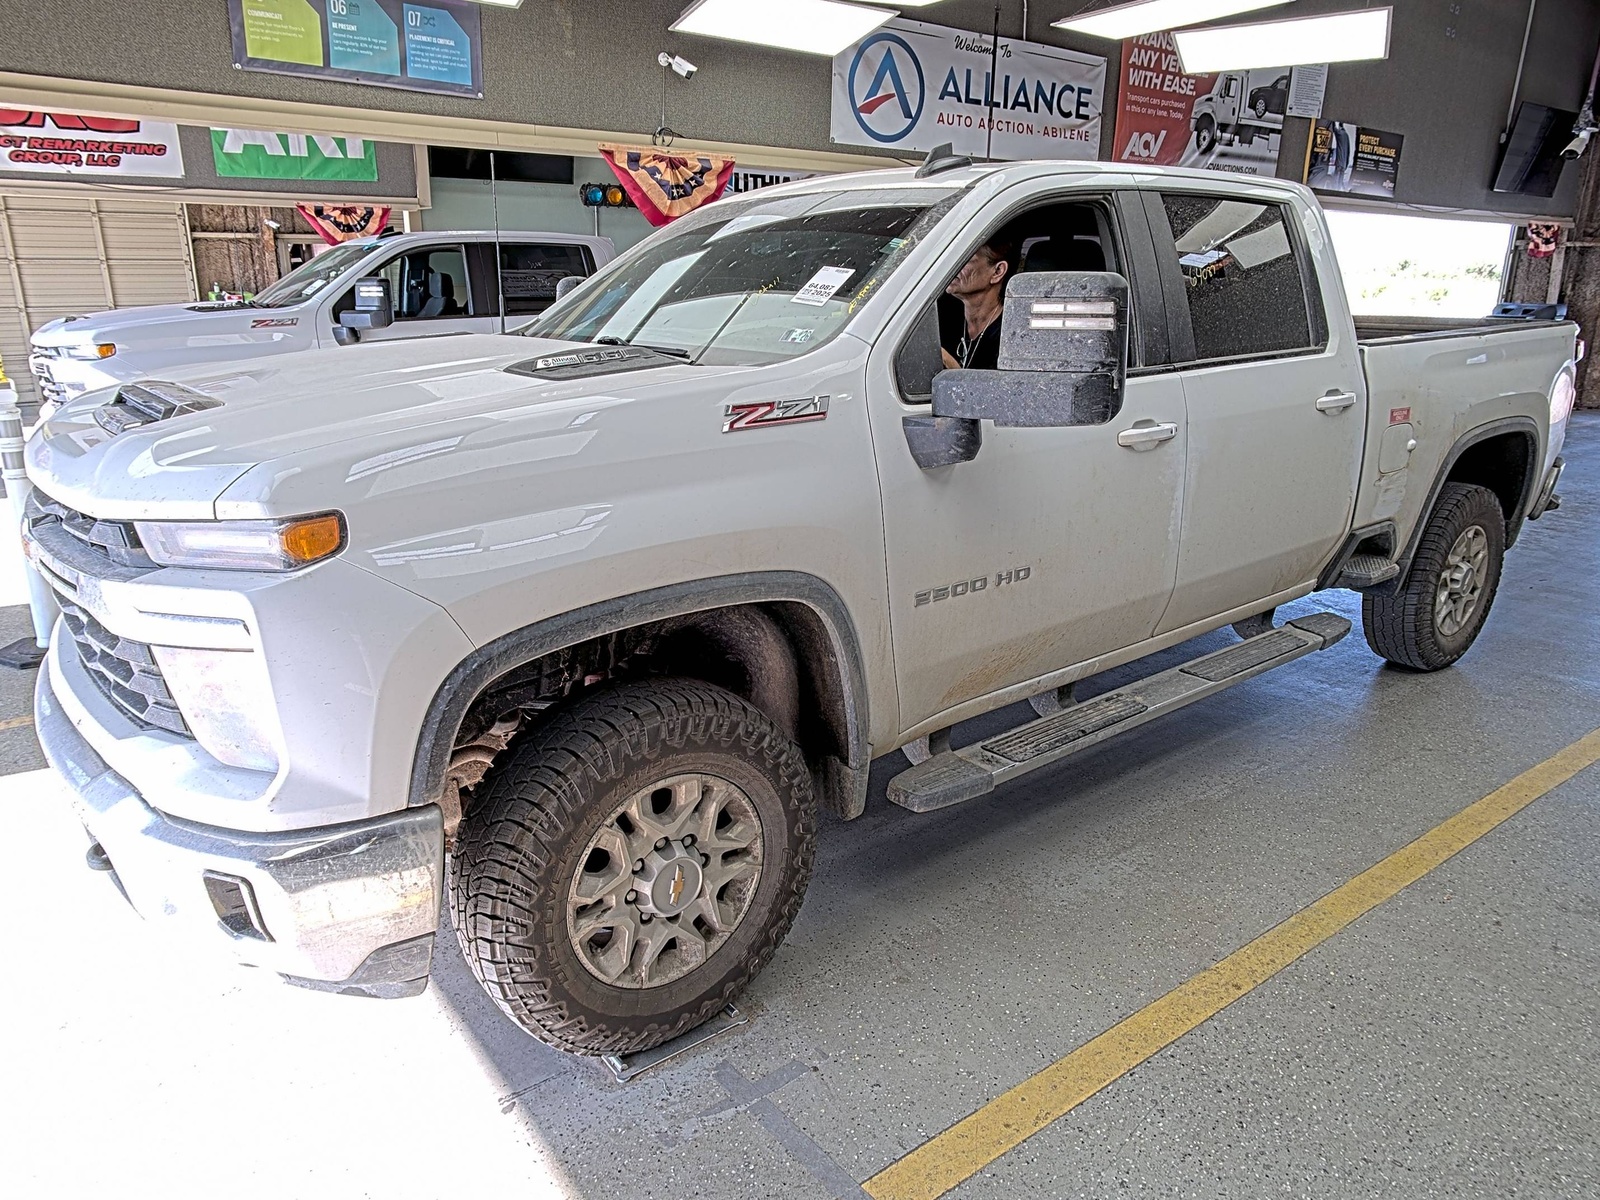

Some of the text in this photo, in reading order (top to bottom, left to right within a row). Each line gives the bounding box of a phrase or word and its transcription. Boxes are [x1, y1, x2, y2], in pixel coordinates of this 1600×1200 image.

[330, 0, 347, 15] 06
[408, 10, 421, 26] 07
[409, 33, 432, 42] PLACEMENT
[437, 37, 455, 47] CRITICAL
[1000, 44, 1012, 58] To
[1129, 47, 1160, 68] ANY
[1128, 68, 1196, 96] WITH EASE.
[938, 66, 1092, 120] ALLIANCE
[1127, 92, 1186, 109] Transport cars purchased
[1126, 103, 1131, 111] in
[1131, 104, 1141, 113] this
[1147, 108, 1156, 116] any
[937, 112, 973, 128] AUTO
[978, 116, 1033, 135] AUCTION
[1042, 126, 1090, 142] ABILENE
[27, 137, 167, 156] REMARKETING
[1121, 130, 1167, 160] ACV
[1359, 143, 1374, 154] EVERY
[1360, 134, 1380, 146] PROTECT
[9, 151, 121, 168] GROUP, LLC
[250, 317, 299, 329] Z71
[721, 394, 830, 434] Z71
[914, 566, 1031, 608] 2500 HD
